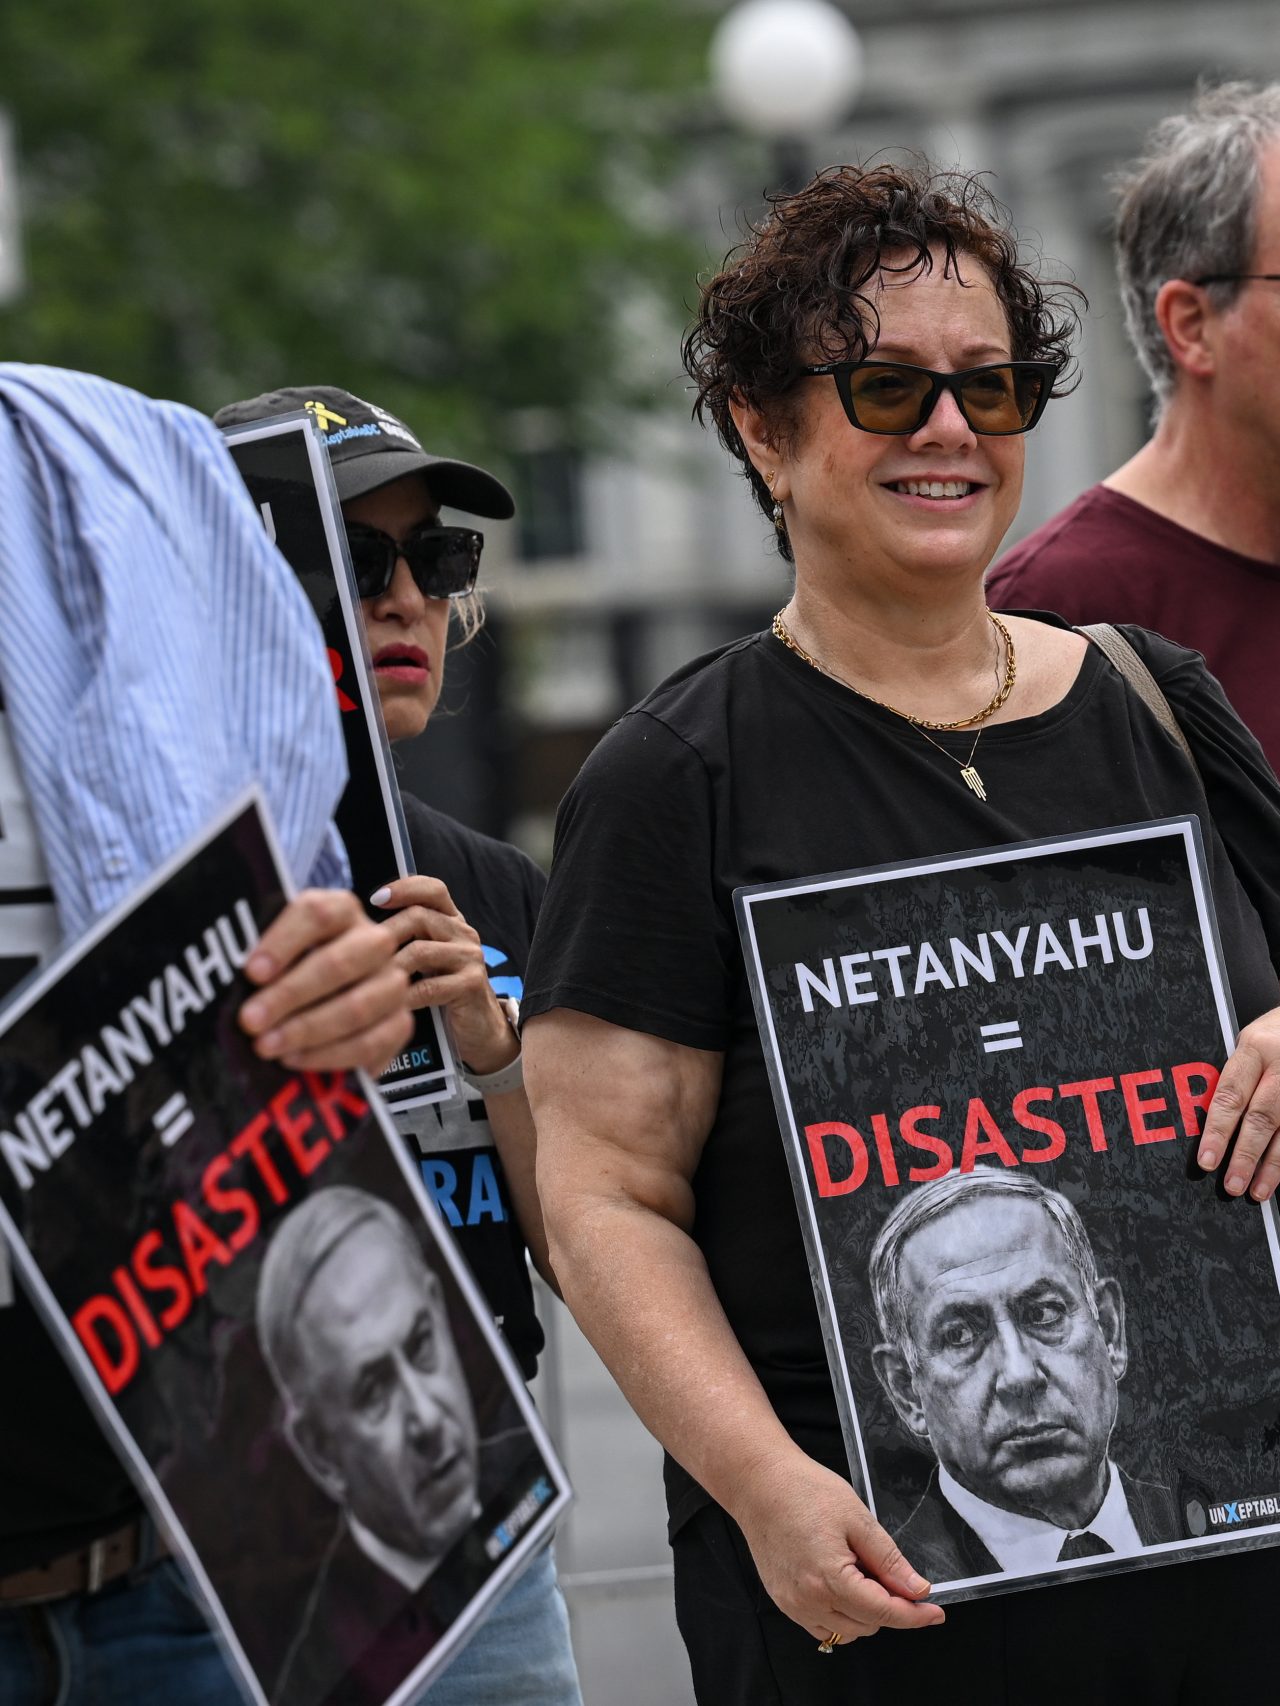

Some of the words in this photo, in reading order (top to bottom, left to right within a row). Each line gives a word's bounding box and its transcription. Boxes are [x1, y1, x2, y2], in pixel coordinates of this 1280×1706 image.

[794, 907, 1155, 1013] NETANYAHU
[0, 899, 259, 1190] NETANYAHU
[411, 1048, 431, 1068] DC
[804, 1061, 1225, 1199] DISASTER
[72, 1068, 370, 1396] DISASTER
